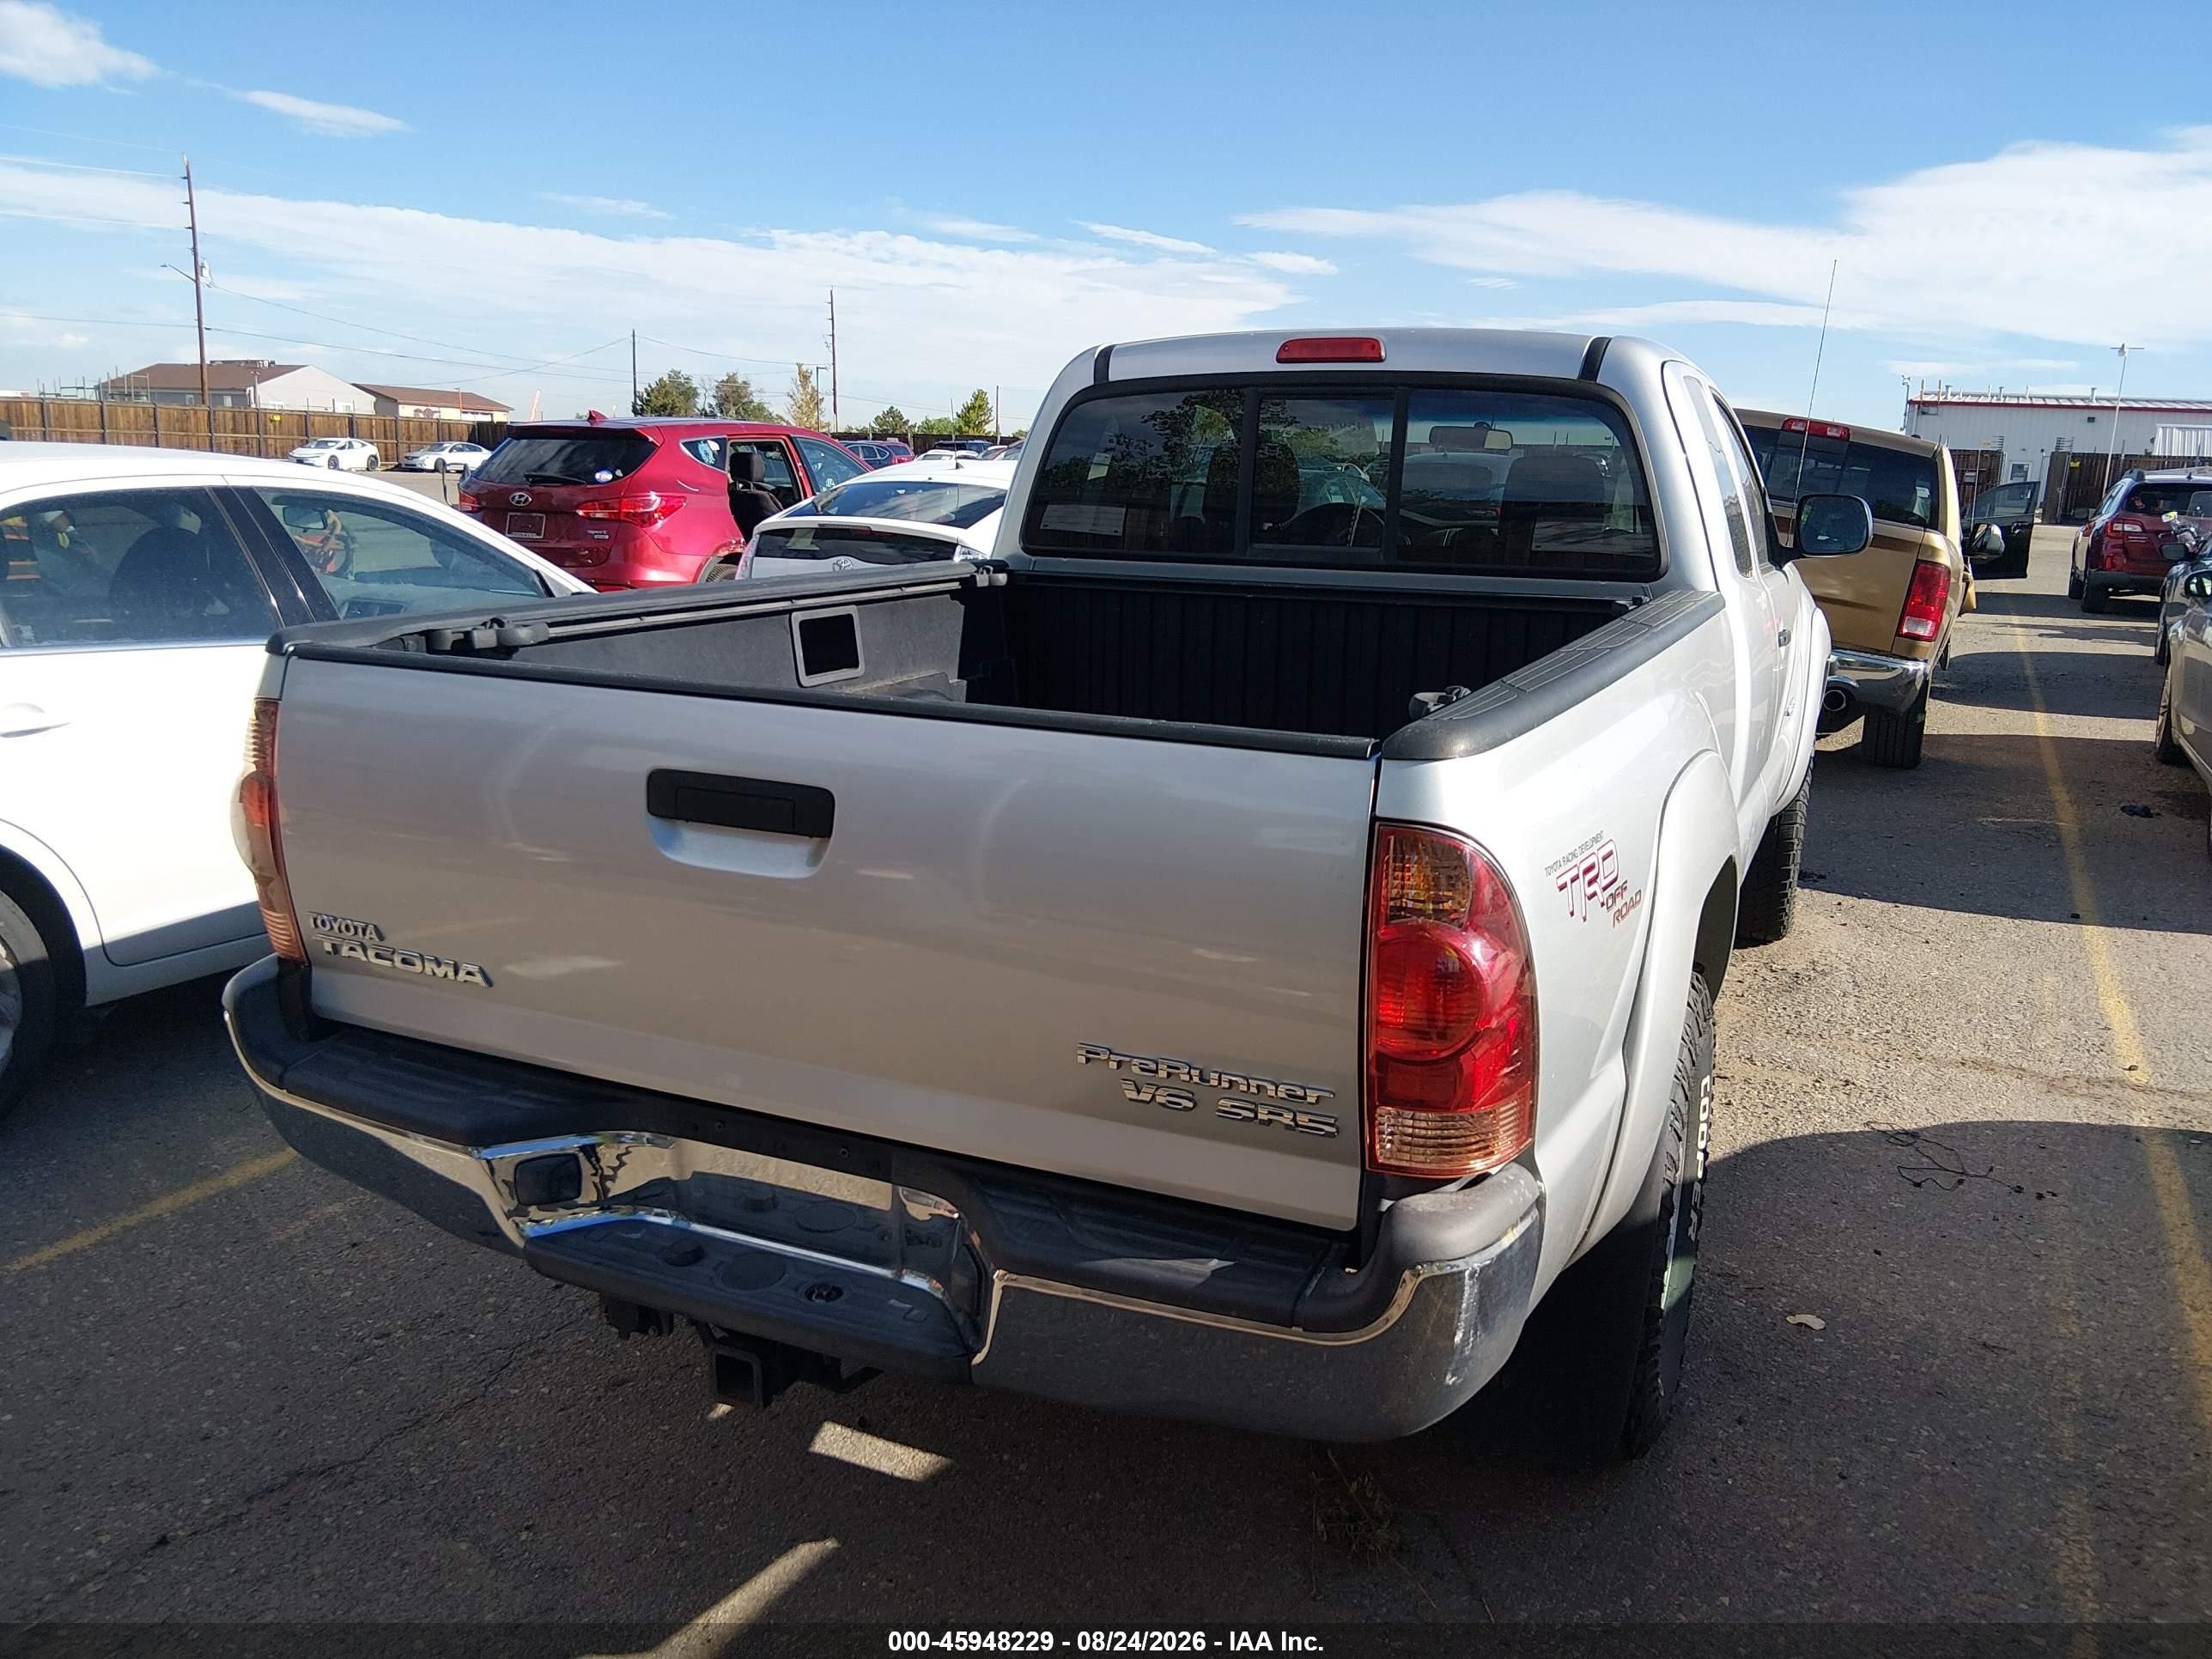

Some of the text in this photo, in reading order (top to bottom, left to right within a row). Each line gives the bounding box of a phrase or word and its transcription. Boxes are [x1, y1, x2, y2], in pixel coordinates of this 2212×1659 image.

[1544, 860, 1562, 877] TOYOTA
[1562, 848, 1578, 866] RACING
[1556, 839, 1620, 922] TRD
[1606, 879, 1628, 911] OFF
[1613, 890, 1642, 928] ROAD
[307, 911, 385, 942] TOYOTA
[312, 933, 494, 988] TACOMA
[1077, 1041, 1335, 1105] PreRunner
[1119, 1078, 1340, 1139] V6 SR5
[1687, 1075, 1711, 1243] COOPER
